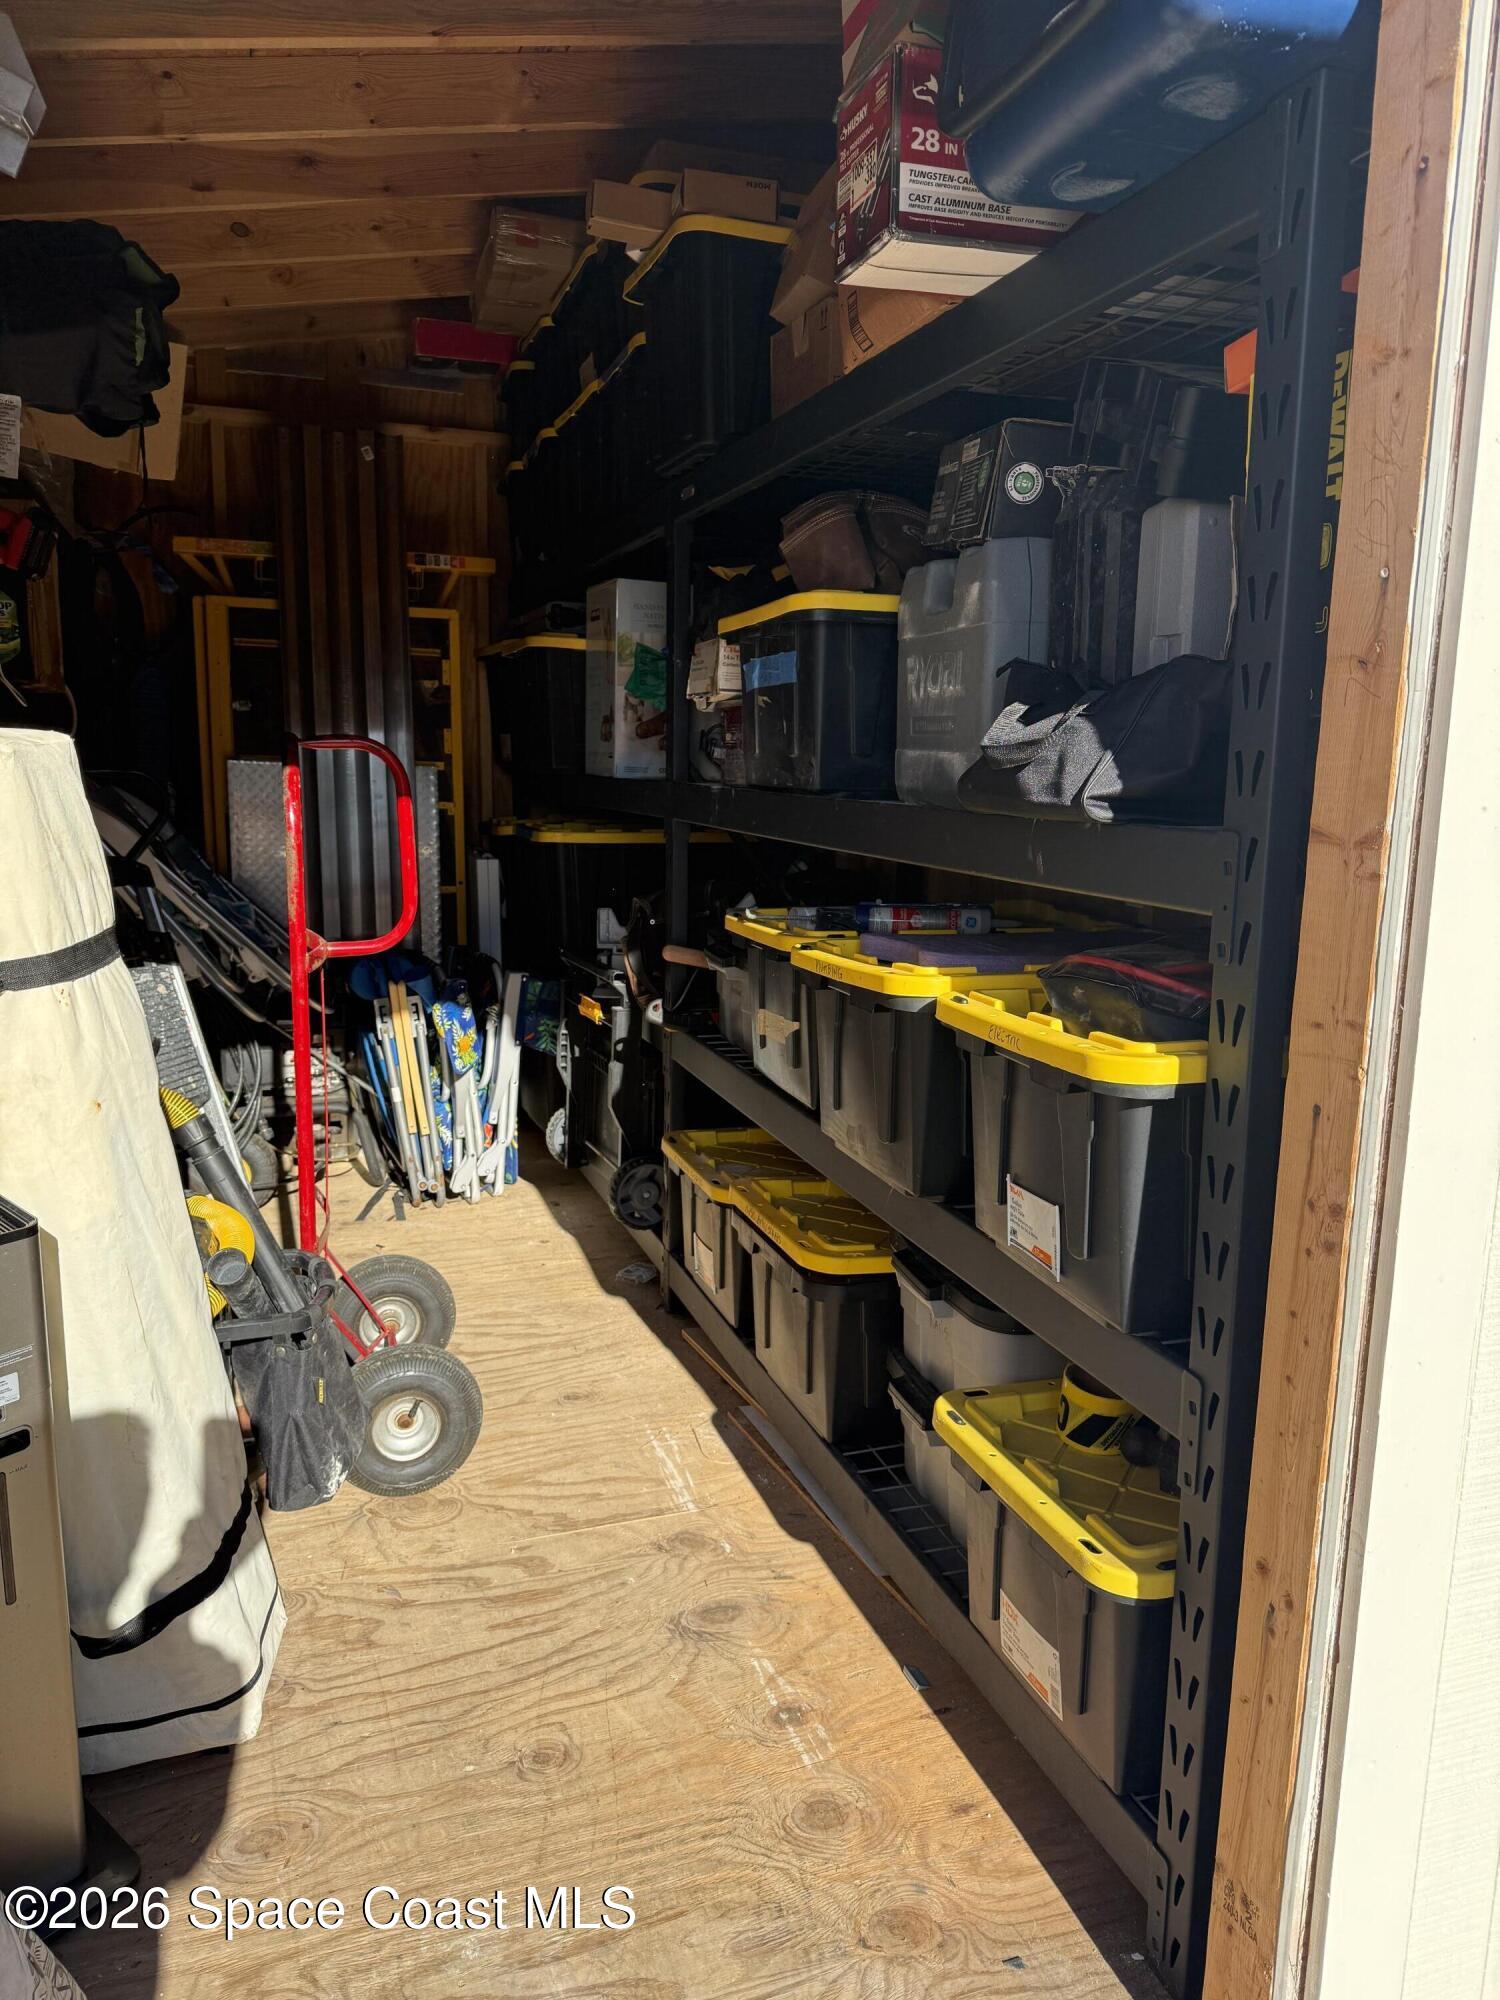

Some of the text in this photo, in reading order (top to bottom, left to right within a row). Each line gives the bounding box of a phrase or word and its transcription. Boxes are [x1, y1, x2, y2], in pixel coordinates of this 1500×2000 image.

[847, 103, 868, 134] HUSKY
[911, 126, 958, 156] 28 IN
[908, 178, 934, 187] PROVIDES
[934, 182, 960, 191] IMPROVED
[909, 168, 976, 187] TUNGSTEN-CAR
[908, 193, 1013, 215] CAST ALUMINUM BASE
[908, 203, 933, 212] IMPROVES
